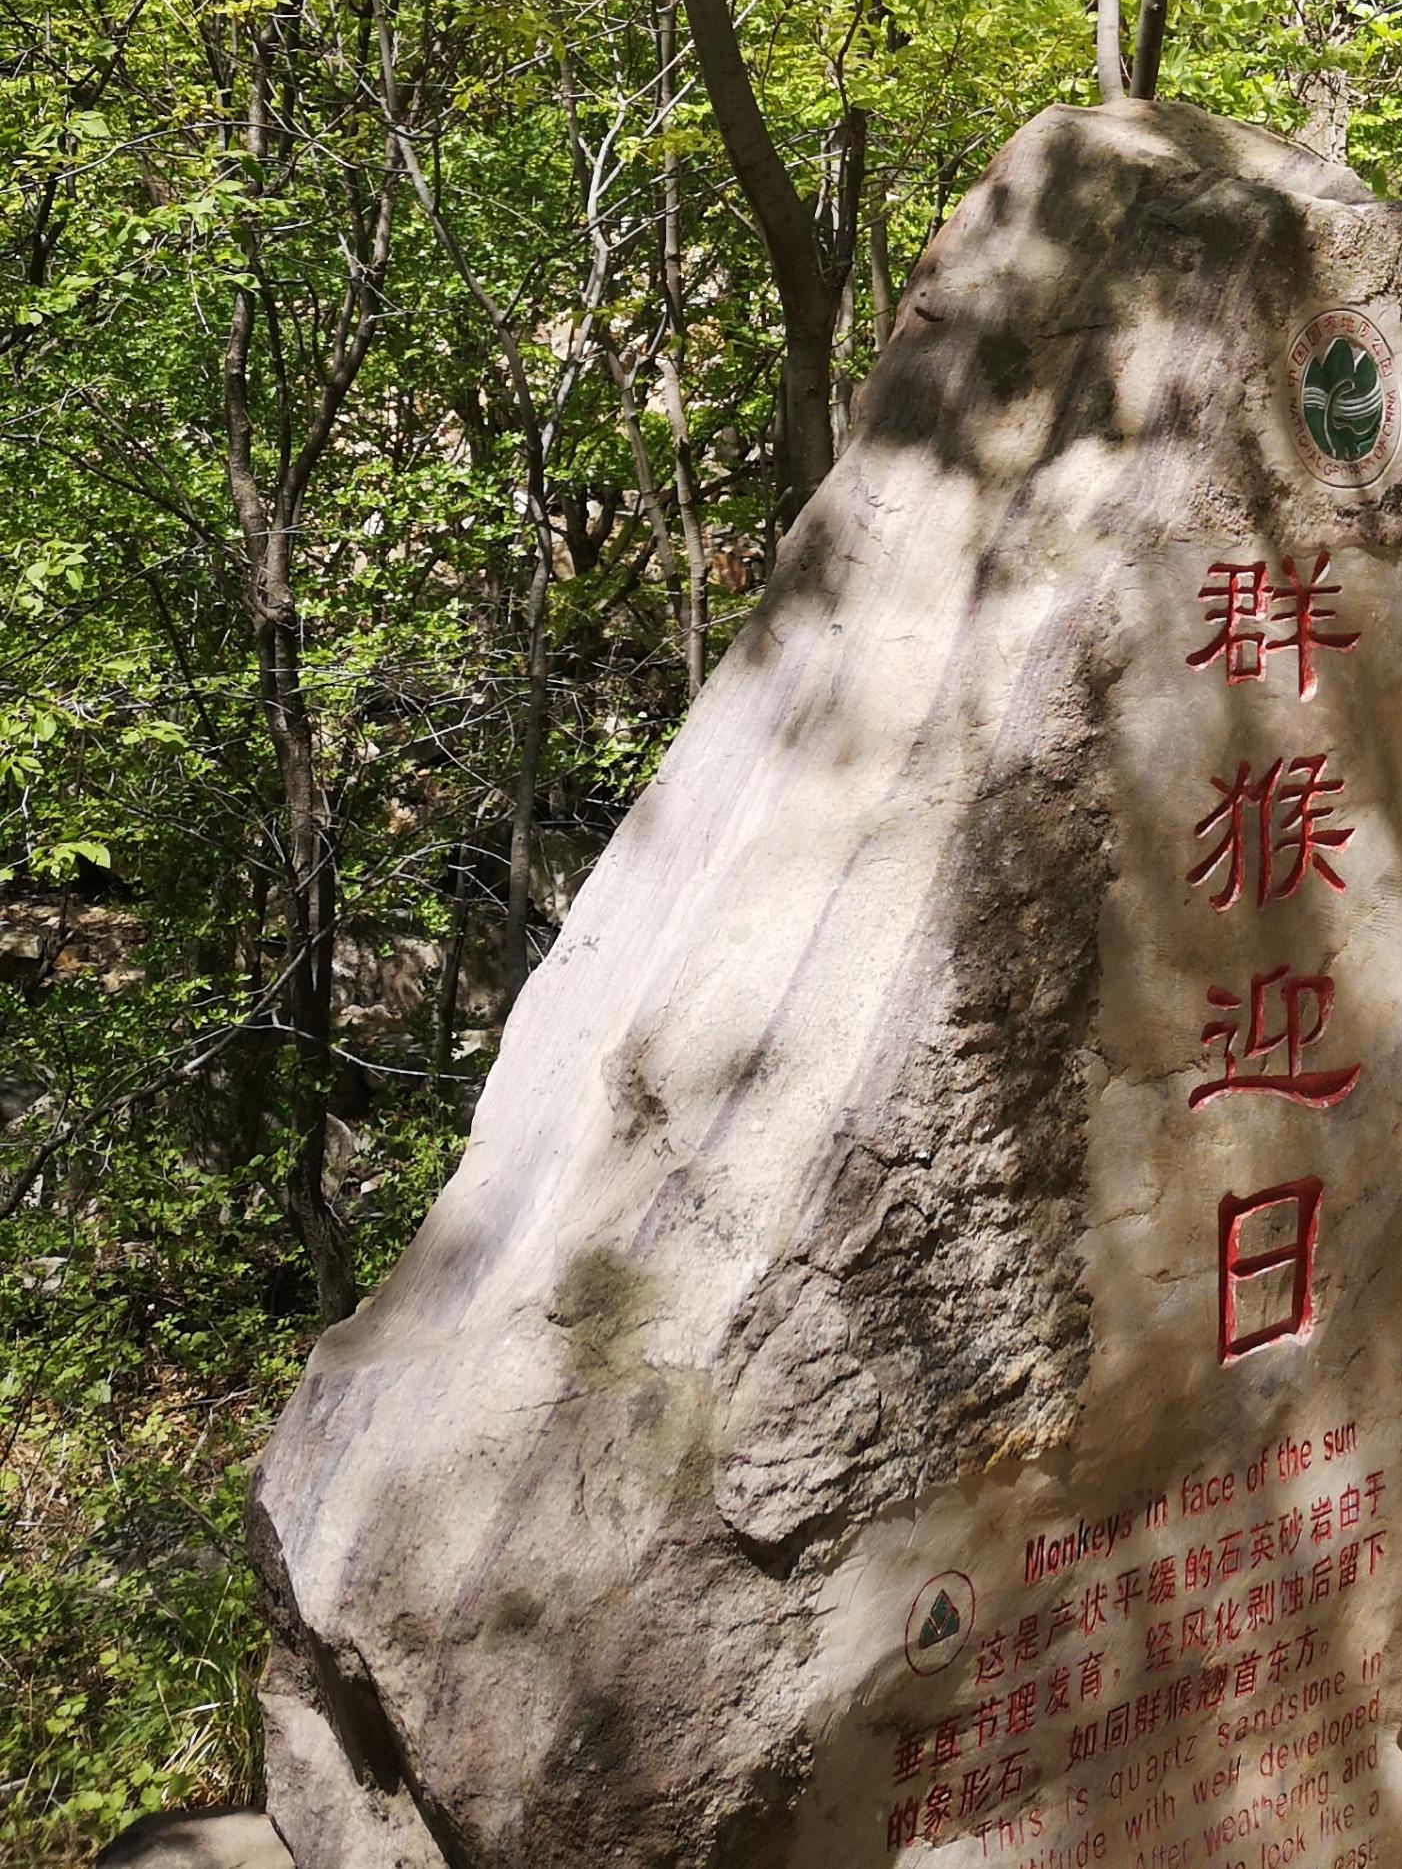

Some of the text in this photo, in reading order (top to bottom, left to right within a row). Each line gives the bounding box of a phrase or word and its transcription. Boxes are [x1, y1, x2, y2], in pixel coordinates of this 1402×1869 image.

[1185, 549, 1362, 1367] 群猴迎日
[975, 1470, 1387, 1685] 这是产状平缓的石英砂岩由于
[1024, 1419, 1358, 1587] Monkeys in face of the sun
[976, 1650, 1381, 1858] This is quartz sandstone in
[1125, 1790, 1175, 1843] with
[1260, 1690, 1380, 1778] developed
[1203, 1769, 1330, 1857] weathering
[1342, 1734, 1378, 1783] and
[1261, 1788, 1380, 1869] look like a
